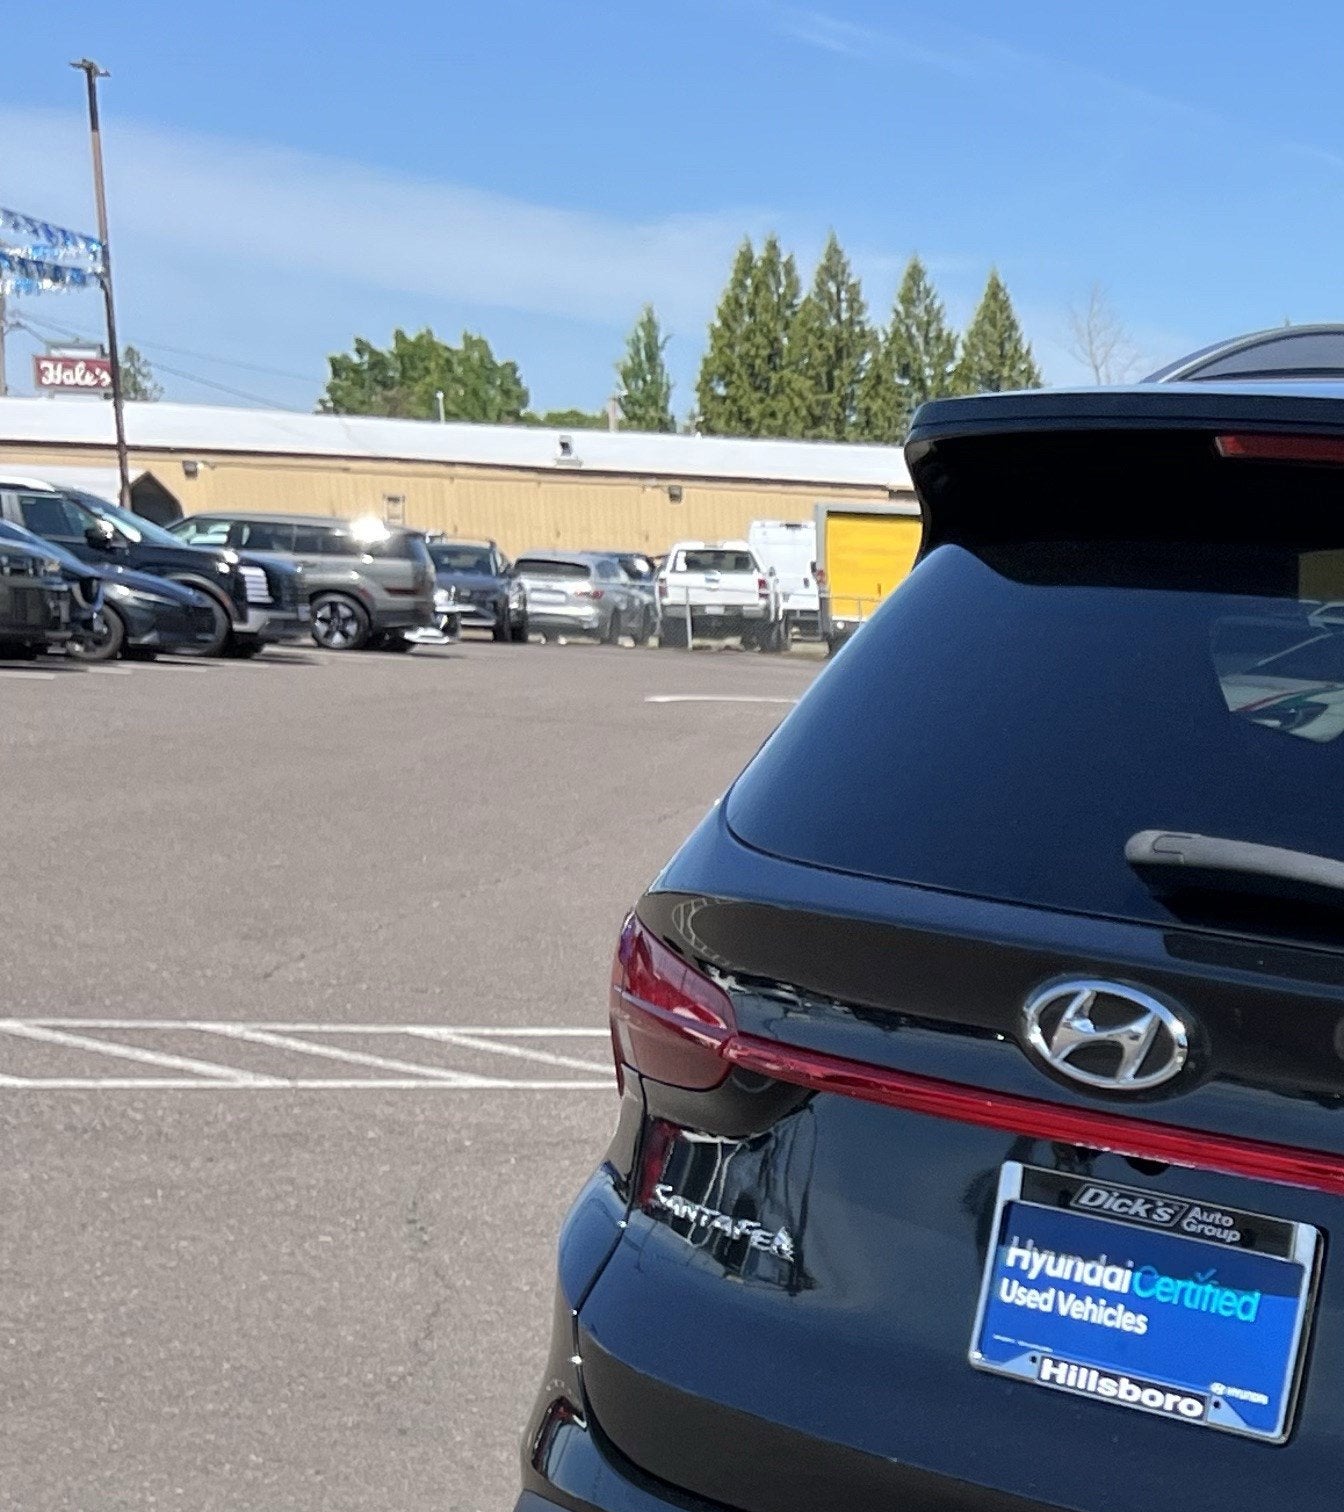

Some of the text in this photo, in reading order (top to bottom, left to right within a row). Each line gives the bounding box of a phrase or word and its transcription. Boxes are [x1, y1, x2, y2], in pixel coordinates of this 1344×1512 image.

[1079, 1187, 1176, 1224] Dick's
[1189, 1206, 1235, 1228] Auto
[1181, 1219, 1242, 1244] Group
[1005, 1235, 1262, 1323] Hyundai Certified
[1000, 1277, 1149, 1335] Used Vehicles
[1039, 1358, 1204, 1418] Hillsboro
